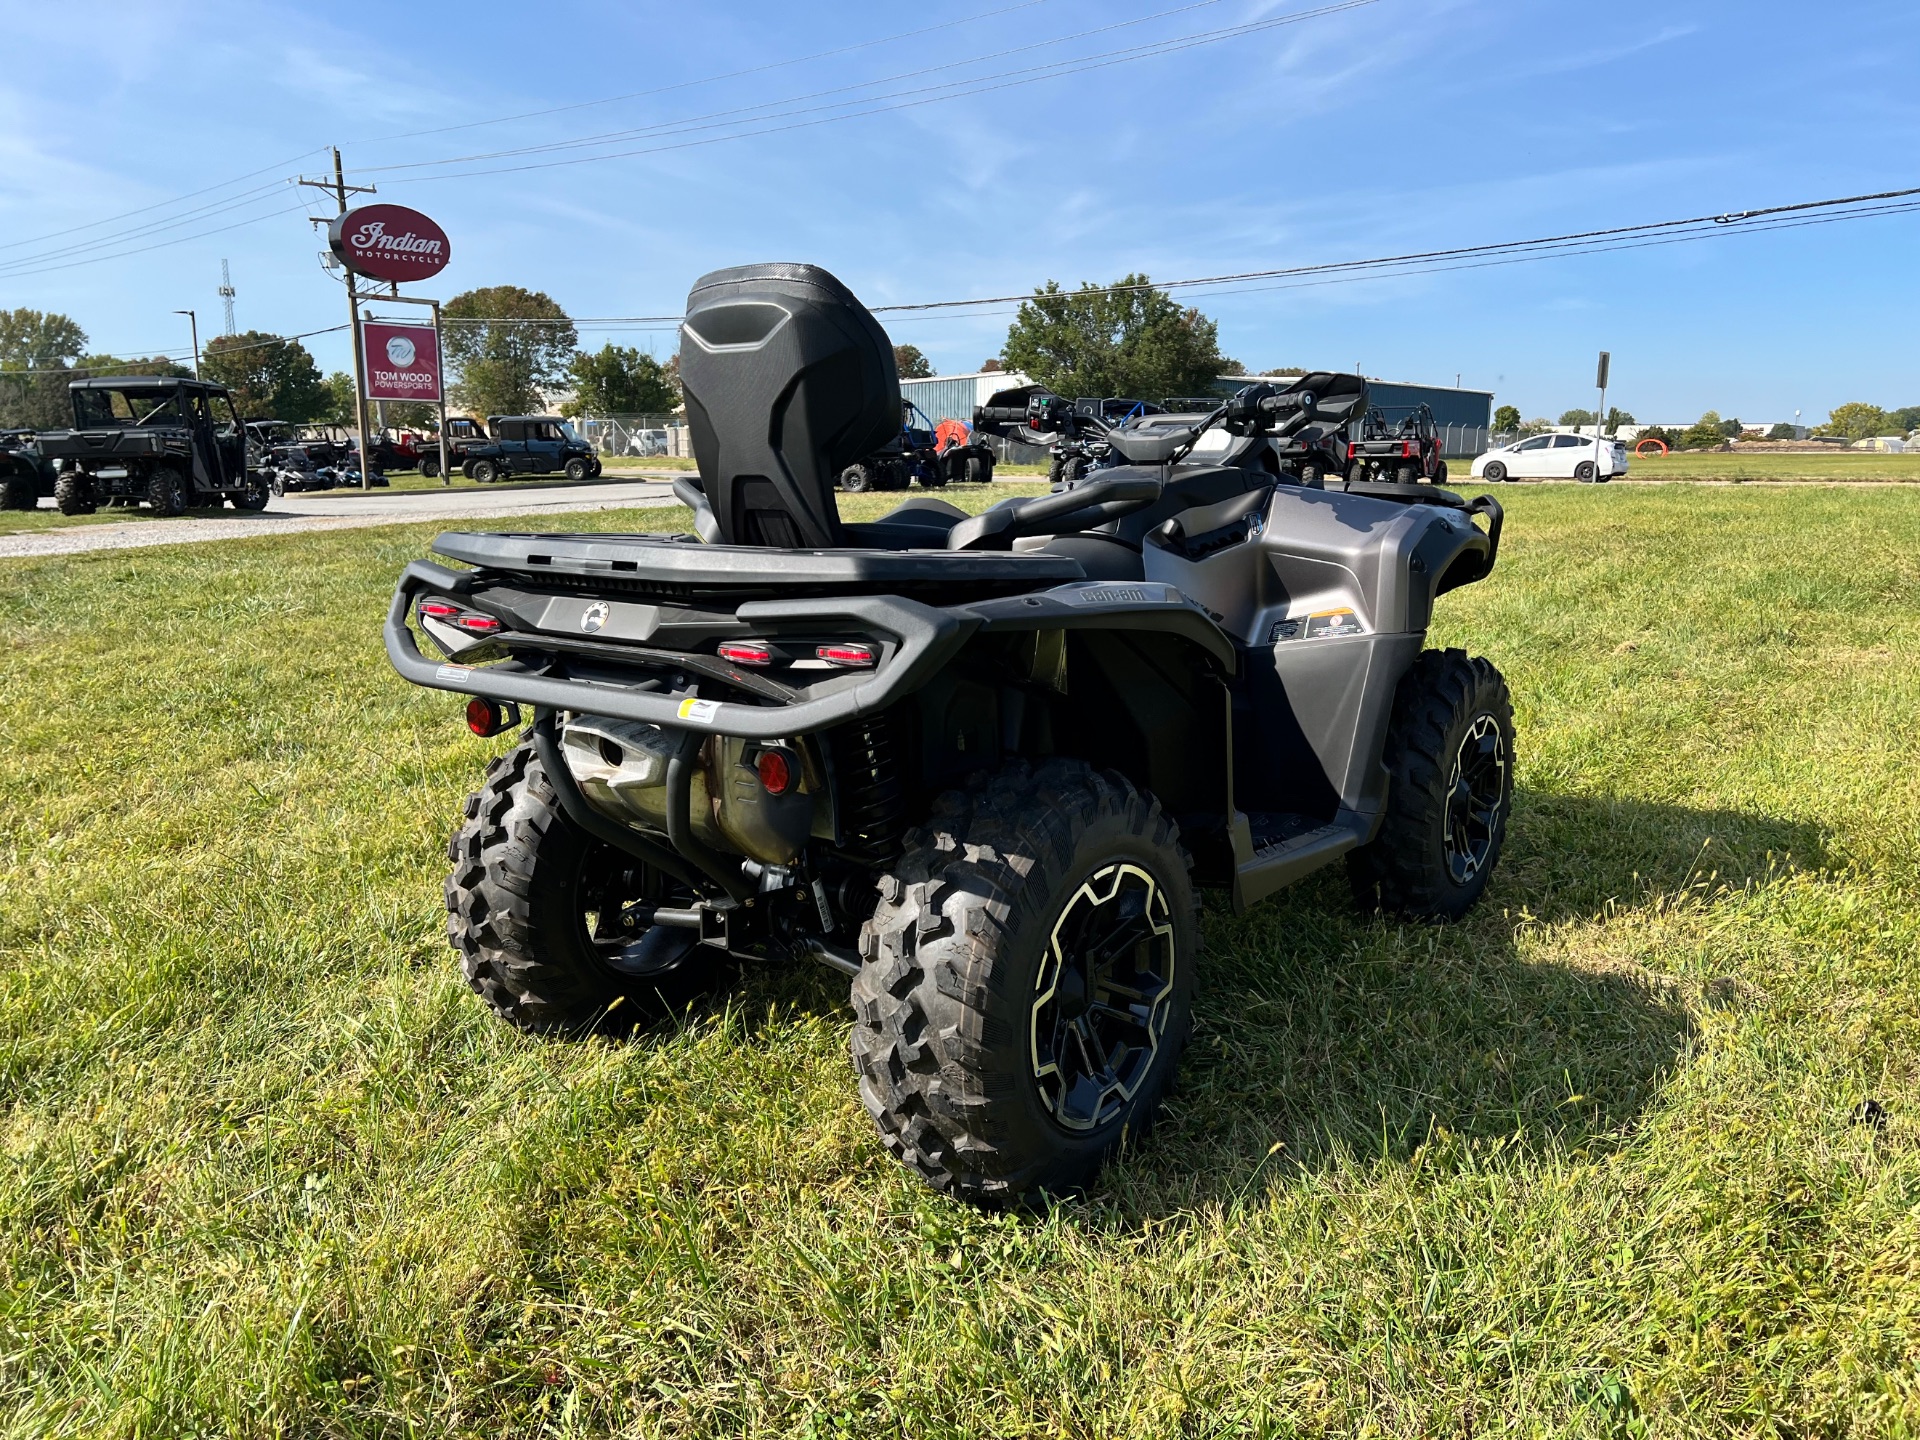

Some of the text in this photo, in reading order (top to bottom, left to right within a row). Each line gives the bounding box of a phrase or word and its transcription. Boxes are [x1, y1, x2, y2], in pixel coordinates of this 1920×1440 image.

[351, 222, 441, 254] Indian
[356, 250, 440, 264] MOTORCYCLE
[374, 371, 432, 382] TOM WOOD
[374, 381, 432, 390] POWERSPORTS
